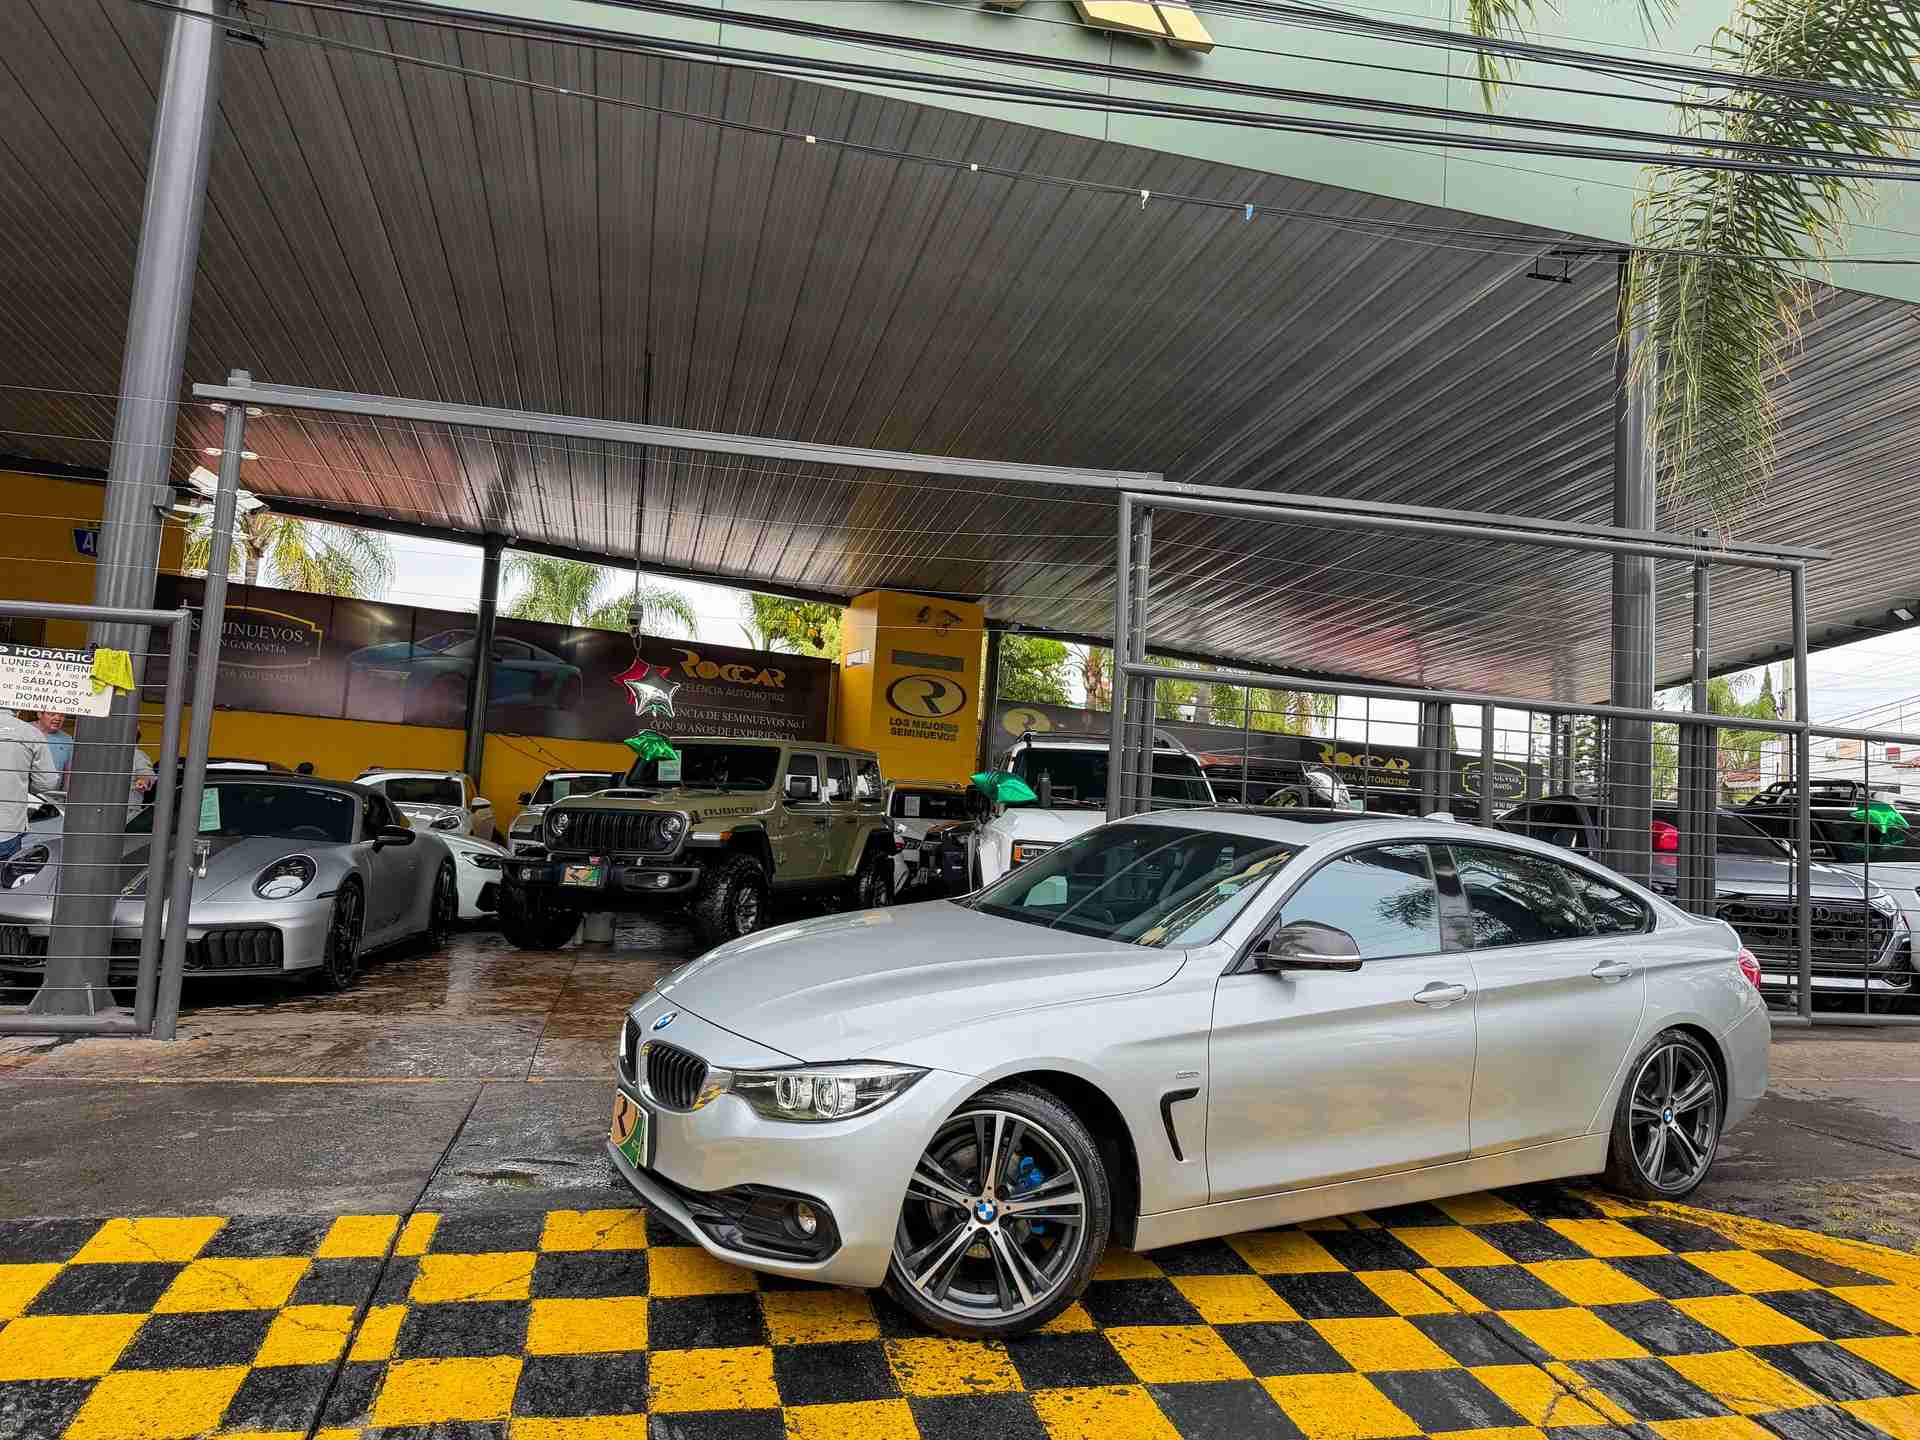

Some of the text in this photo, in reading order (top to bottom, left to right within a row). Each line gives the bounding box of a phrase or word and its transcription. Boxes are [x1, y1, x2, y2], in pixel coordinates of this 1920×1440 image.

[191, 616, 304, 643] SINUEVOS
[2, 656, 92, 675] LUNES A VIERN
[15, 692, 80, 706] DOMINGOS
[726, 687, 785, 703] AUTOMOTRIZ
[721, 712, 785, 728] SEMINUEVOS
[889, 717, 910, 728] LOS
